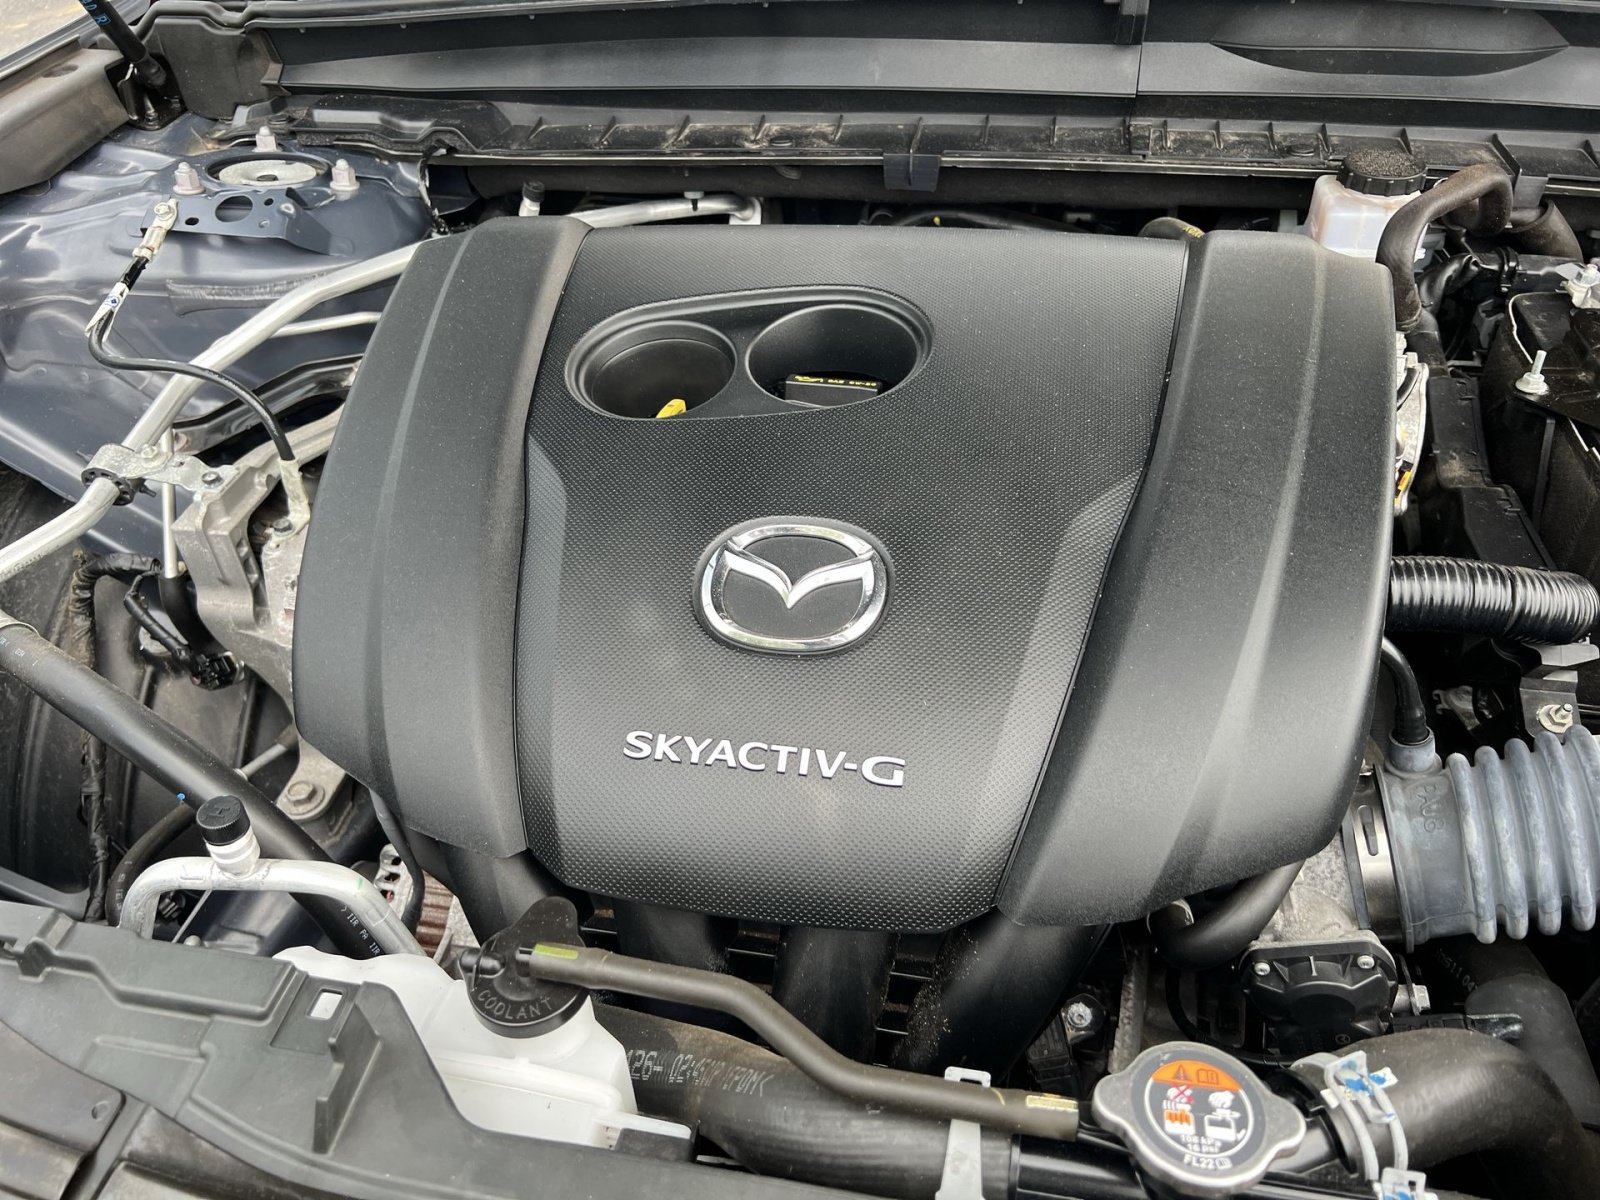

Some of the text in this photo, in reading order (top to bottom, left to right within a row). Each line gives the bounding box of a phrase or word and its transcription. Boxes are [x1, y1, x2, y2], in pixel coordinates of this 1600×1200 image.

[622, 730, 907, 788] SKYACTIV-G
[477, 989, 552, 1020] COOLANT
[1200, 1136, 1222, 1147] kPa
[1202, 1145, 1220, 1154] psi
[1183, 1153, 1216, 1169] FL22
